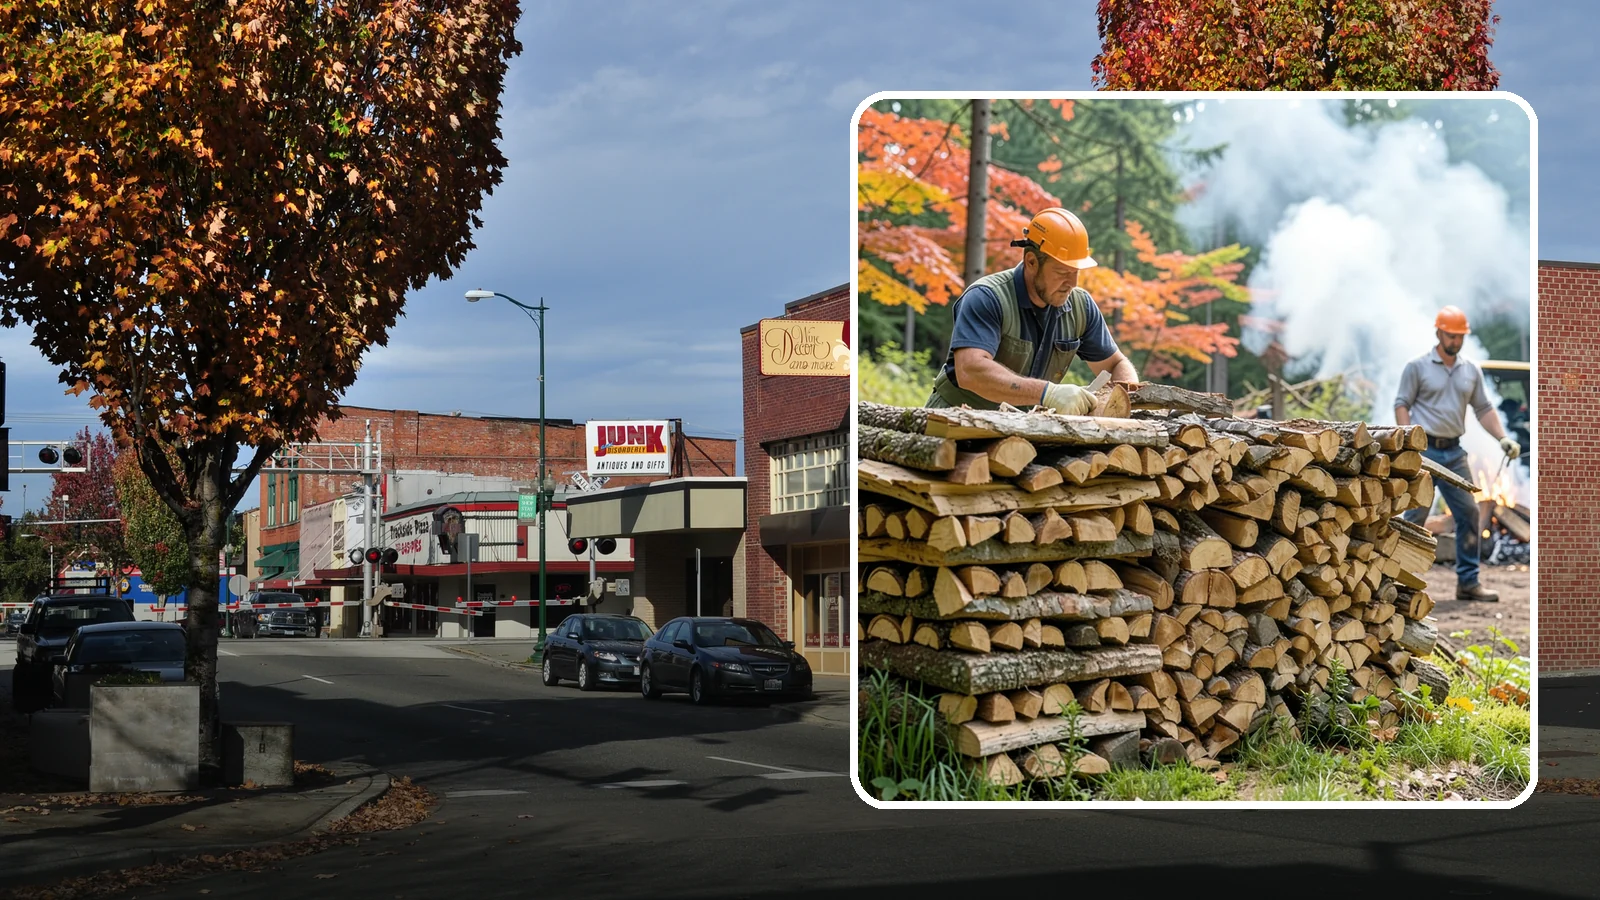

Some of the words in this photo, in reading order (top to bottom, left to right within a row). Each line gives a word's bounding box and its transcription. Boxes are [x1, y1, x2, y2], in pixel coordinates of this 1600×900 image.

[595, 425, 665, 457] JUNK
[607, 446, 646, 454] DISORDERLY
[597, 461, 628, 470] ANTIQUES
[631, 461, 643, 470] AND
[647, 460, 666, 470] GIFTS
[573, 473, 588, 490] RAIL
[352, 498, 365, 511] CRO
[390, 521, 413, 540] Trackside
[414, 519, 429, 534] Pizza
